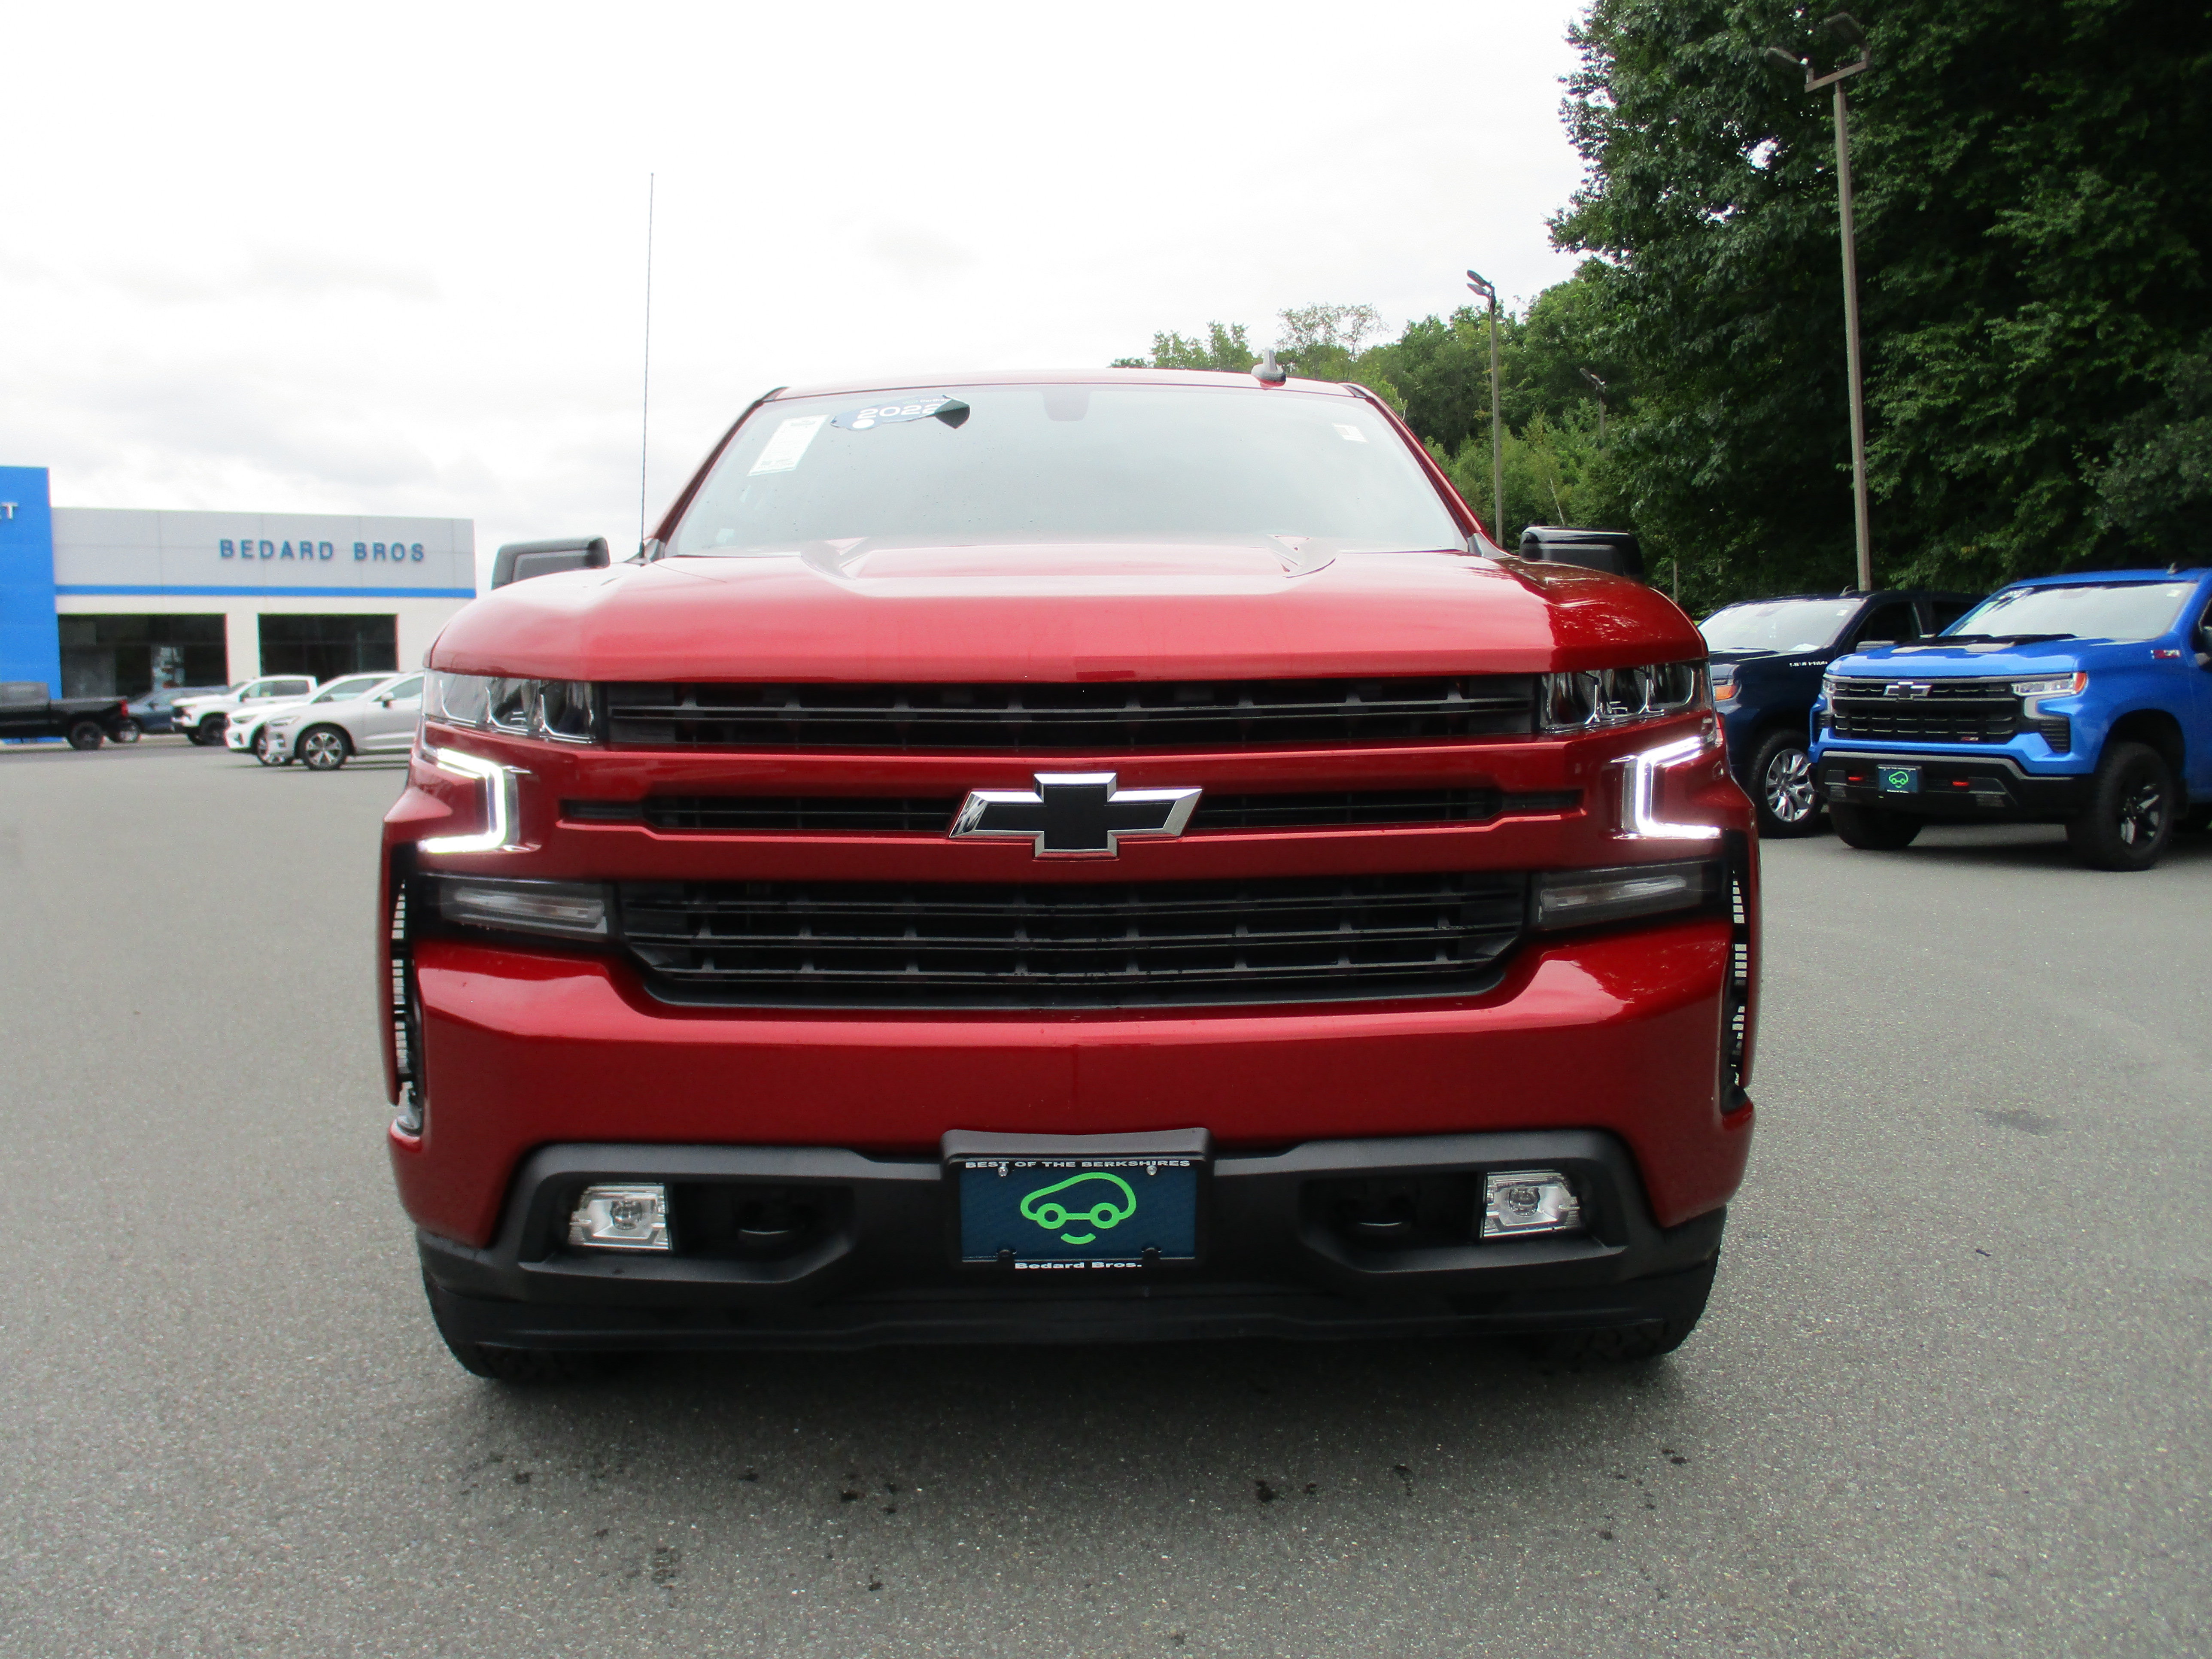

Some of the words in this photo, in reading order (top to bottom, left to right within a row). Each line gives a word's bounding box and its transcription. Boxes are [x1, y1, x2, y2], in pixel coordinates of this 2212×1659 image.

[857, 404, 942, 419] 2022
[219, 539, 334, 560] BEDARD
[353, 541, 424, 562] BROS
